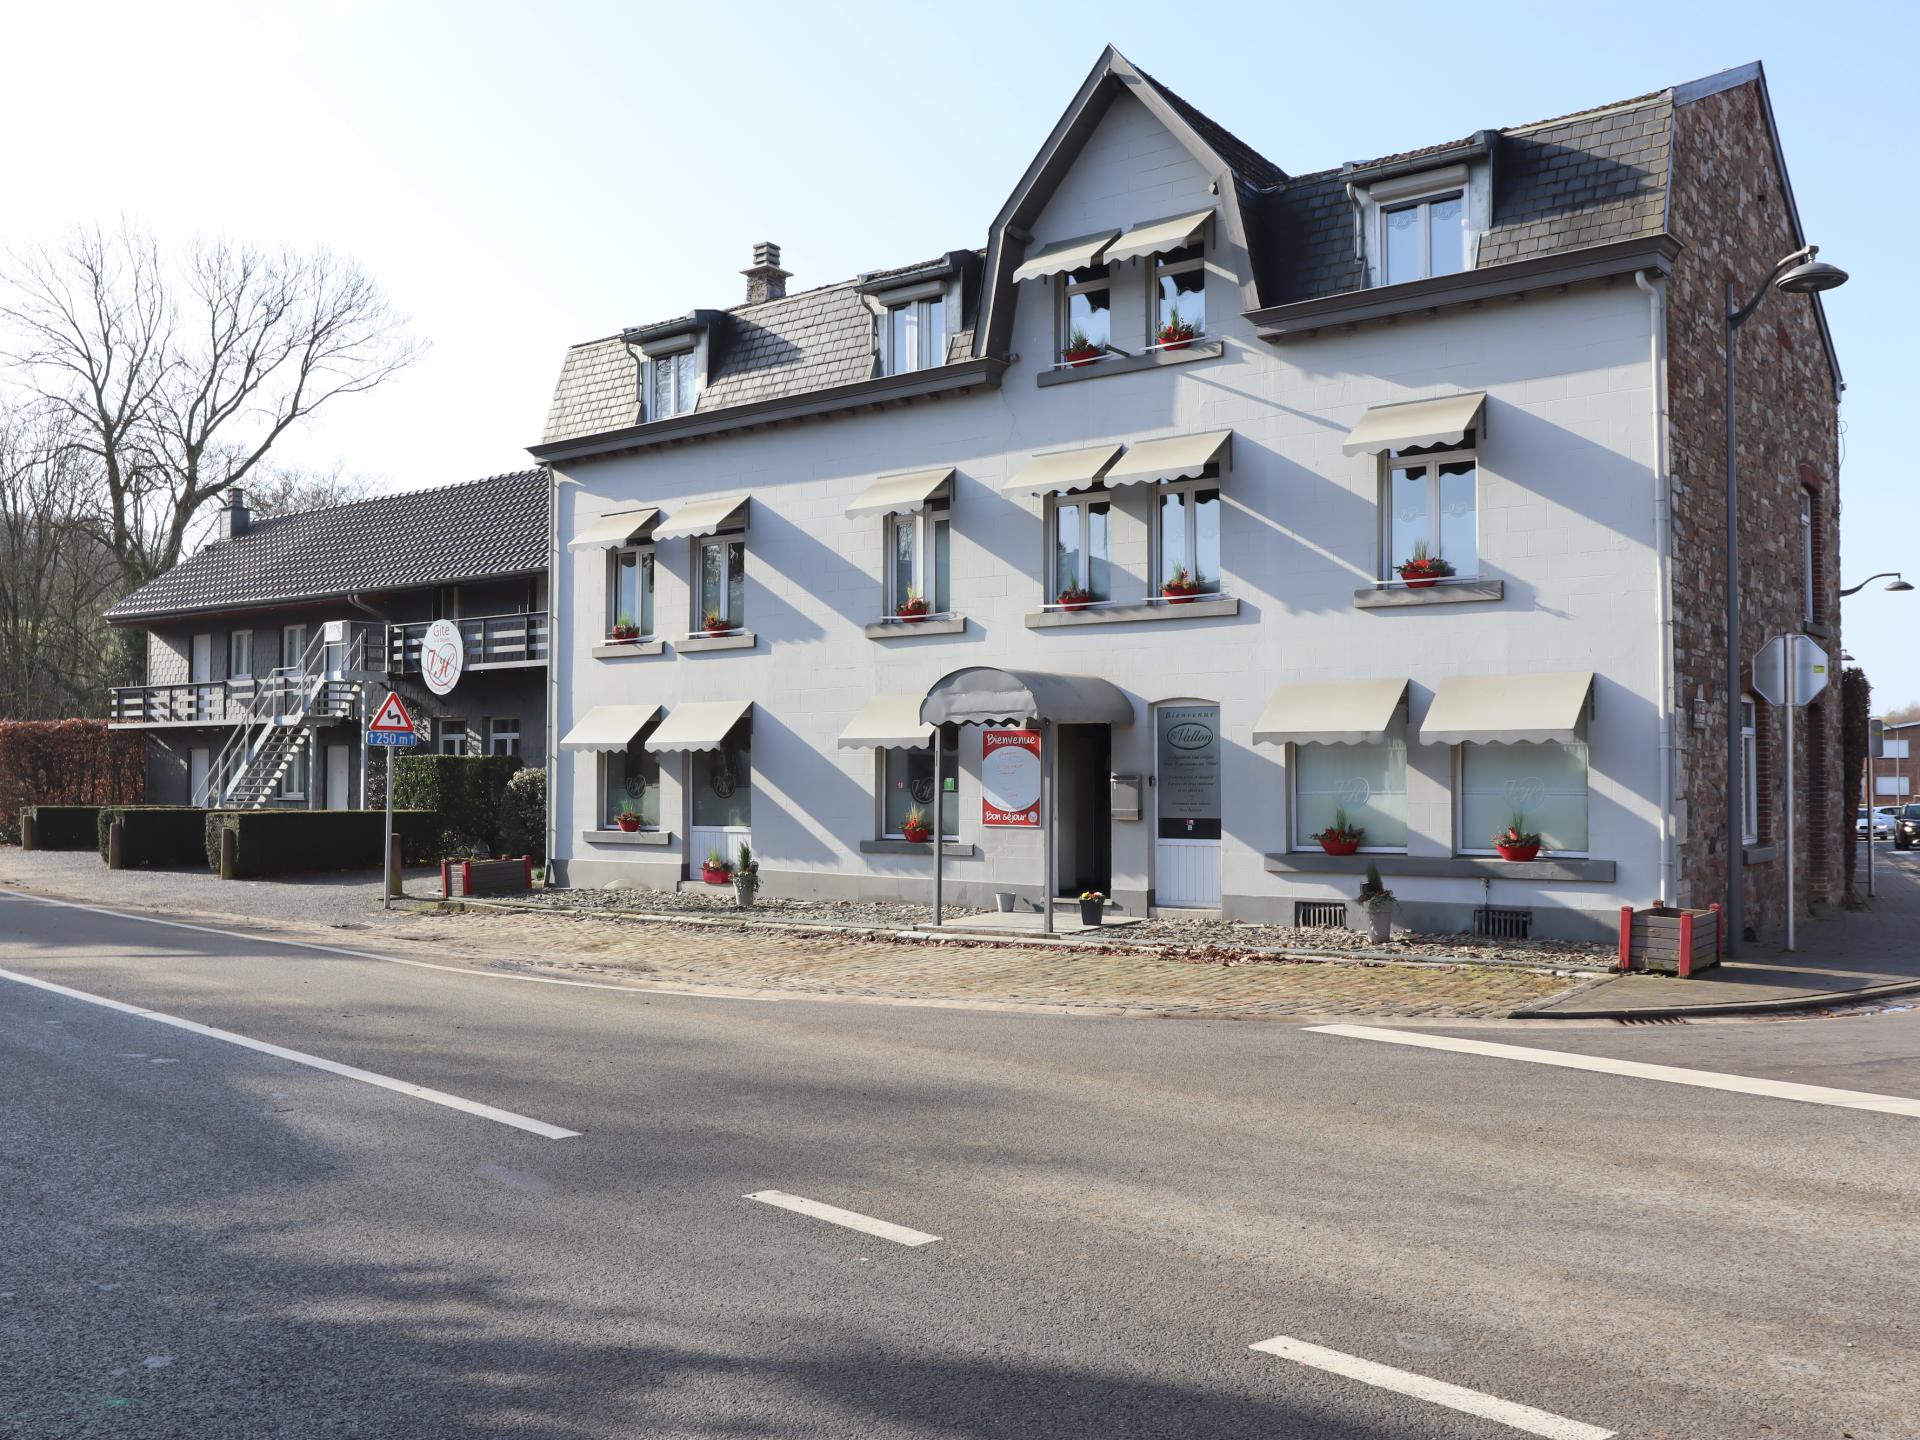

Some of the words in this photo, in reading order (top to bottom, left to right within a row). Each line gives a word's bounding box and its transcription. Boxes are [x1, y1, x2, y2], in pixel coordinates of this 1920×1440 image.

[376, 733, 397, 744] 250
[400, 735, 408, 744] m
[986, 733, 1036, 745] Bienvenue
[985, 811, 1001, 821] Bon
[1002, 810, 1027, 823] séjour
